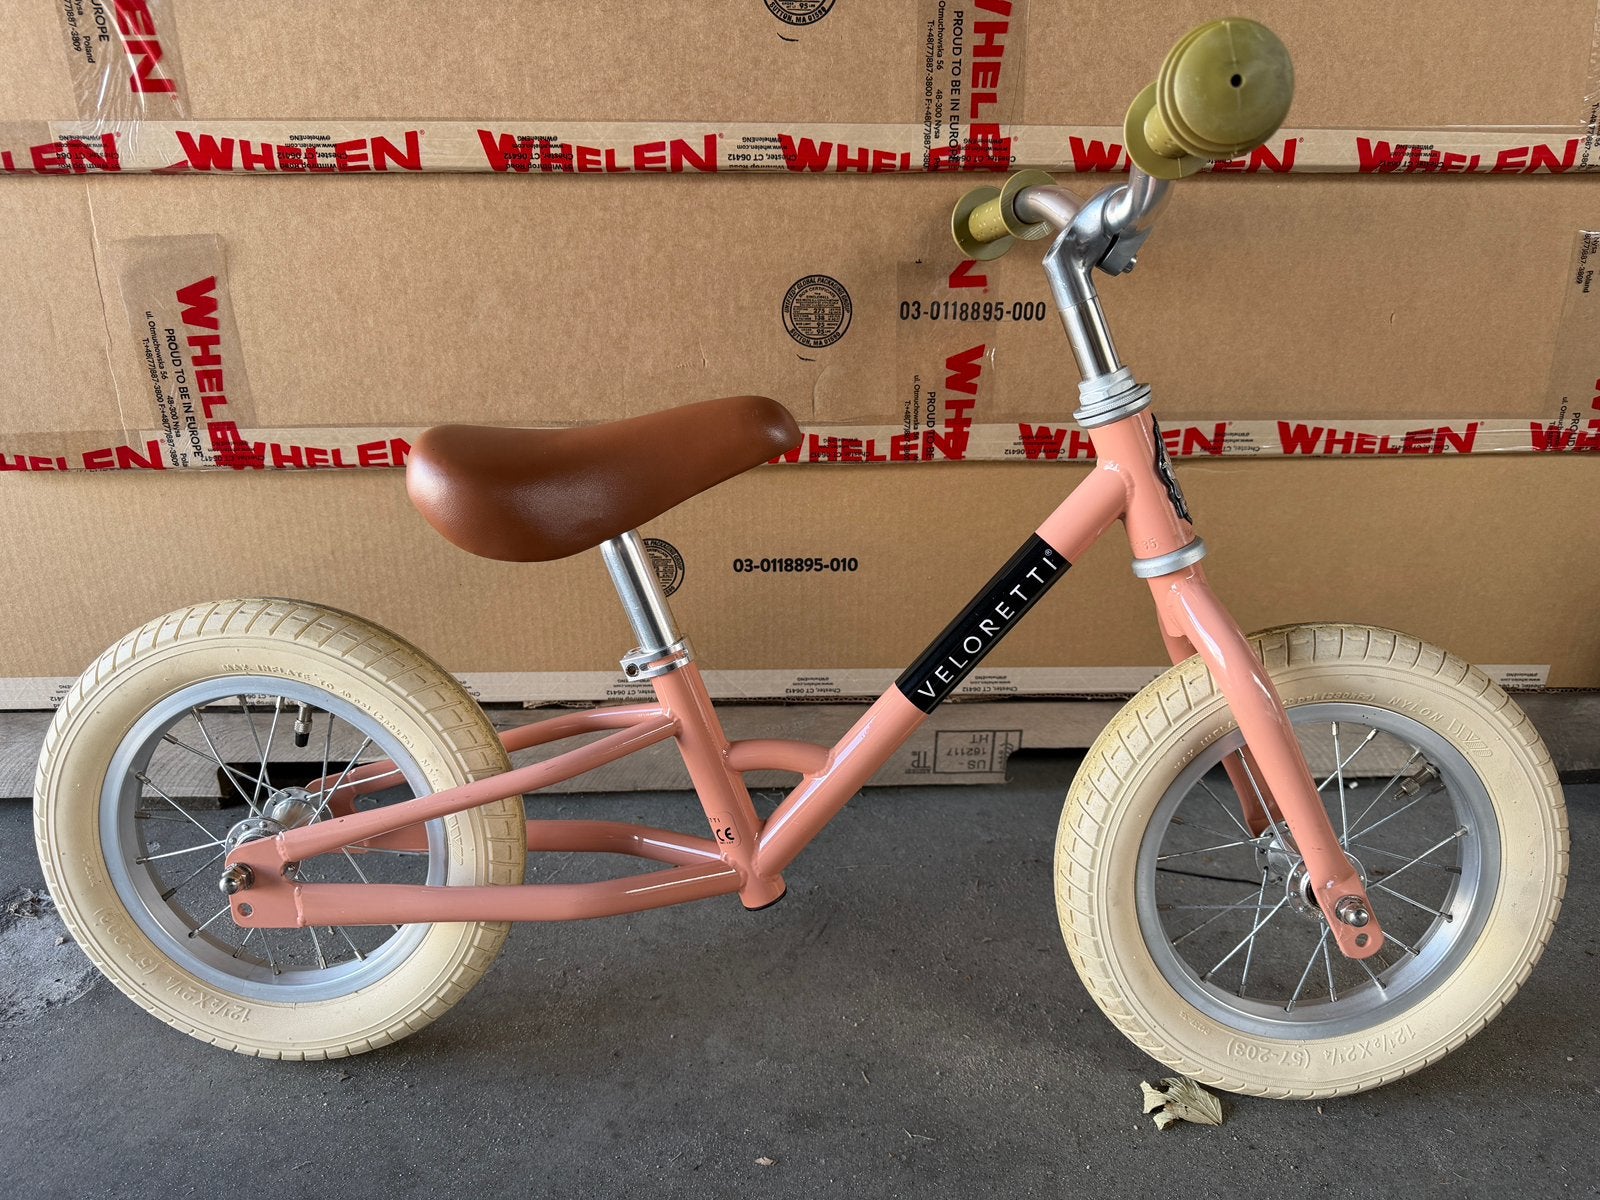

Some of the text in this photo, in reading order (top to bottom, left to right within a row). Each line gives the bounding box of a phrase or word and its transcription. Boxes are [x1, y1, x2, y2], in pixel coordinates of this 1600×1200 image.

[952, 10, 963, 56] PROUD
[83, 35, 95, 64] Poland
[933, 0, 946, 139] Otmuchowska 56 48-300 Nysa
[951, 59, 962, 76] TO
[950, 80, 961, 95] BE
[950, 98, 960, 111] IN
[175, 130, 424, 173] WHELEN
[477, 129, 719, 173] WHELEN
[530, 152, 541, 160] CT
[1356, 136, 1580, 175] WHELEN
[1583, 270, 1594, 293] Poland
[145, 311, 154, 319] ul.
[900, 301, 1046, 321] 03-0118895-000
[148, 321, 165, 369] Otmuchowska
[160, 371, 168, 380] 56
[165, 328, 203, 458] PROUD TO BE IN EUROPE
[167, 396, 178, 420] 48-300
[926, 392, 936, 428] PROUD
[172, 421, 181, 438] Nysa
[1277, 421, 1478, 455] WHELEN
[733, 557, 859, 573] 03-0118895-010
[1388, 696, 1443, 722] NYLON
[969, 734, 989, 744] HT
[968, 760, 986, 770] US
[716, 827, 735, 841] CE
